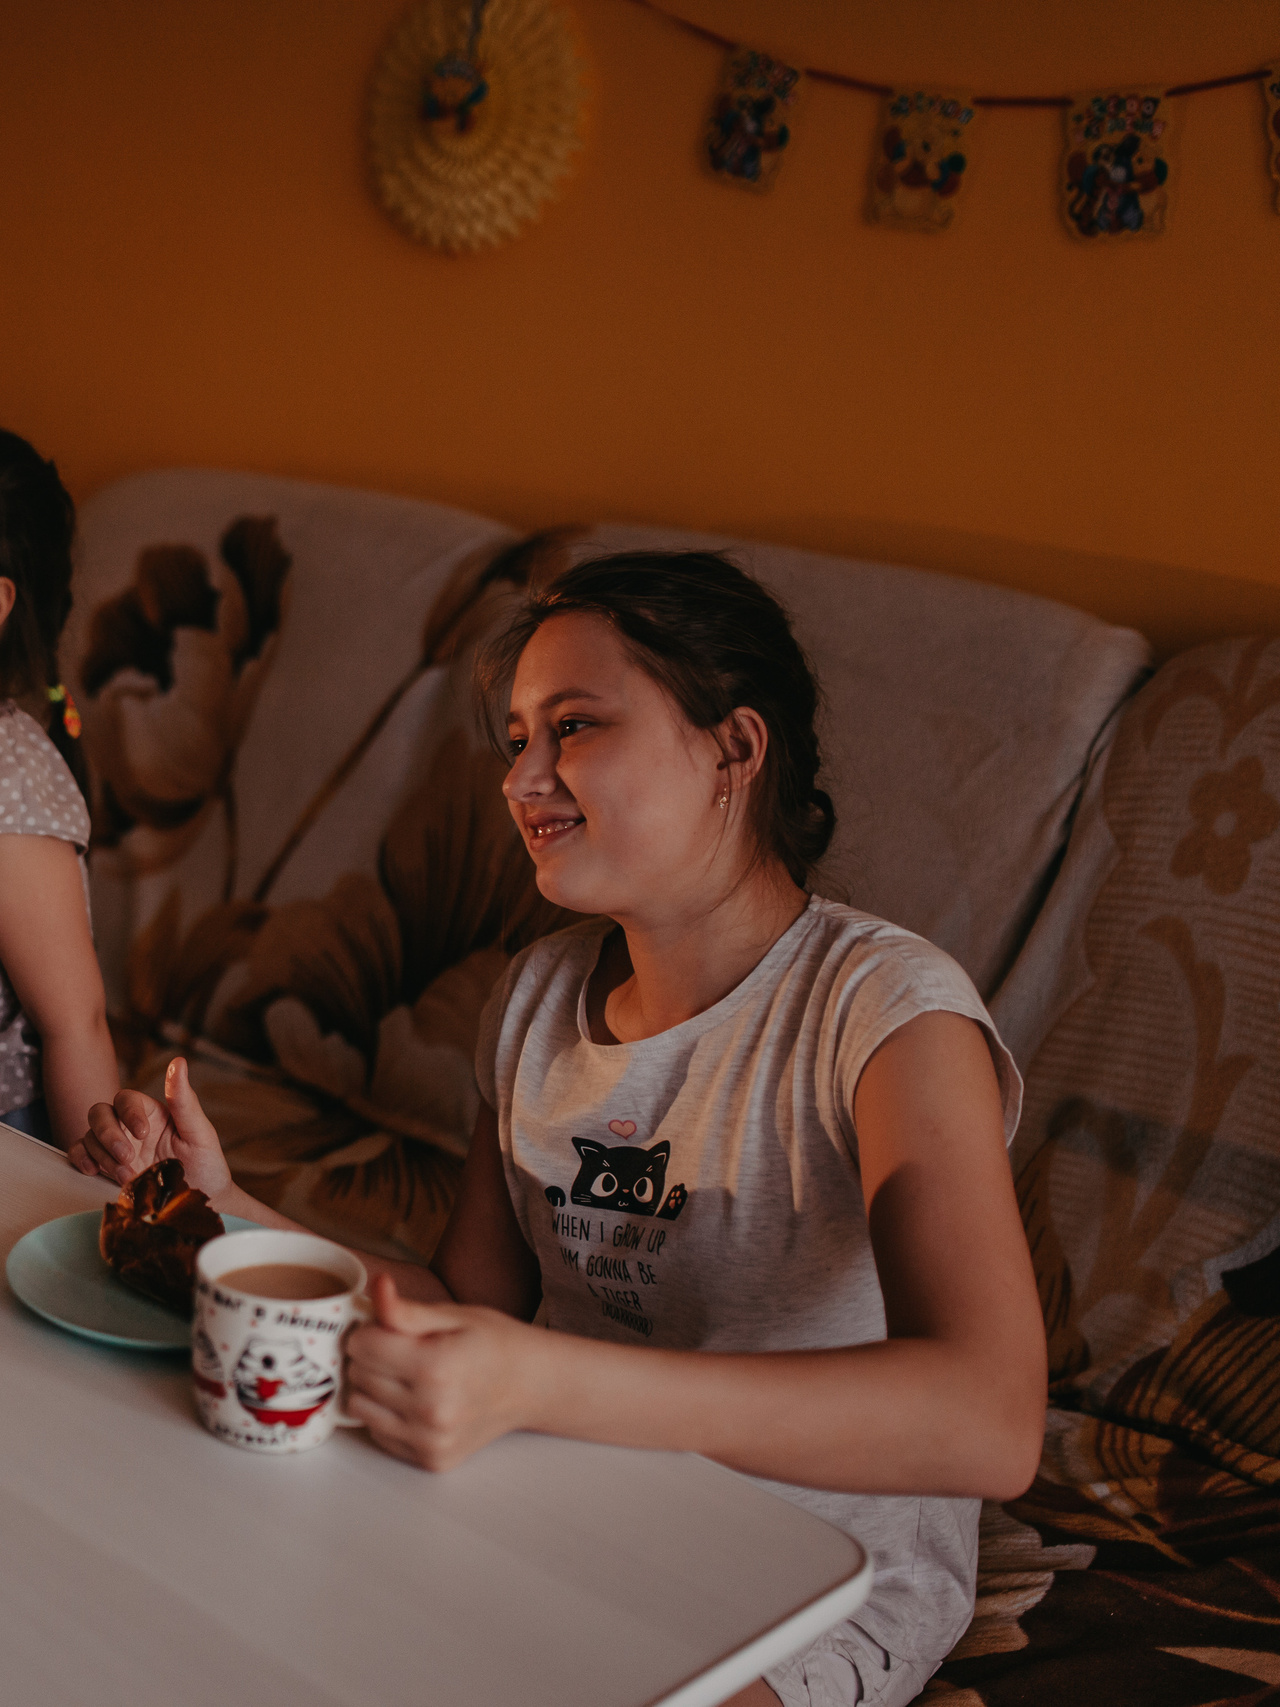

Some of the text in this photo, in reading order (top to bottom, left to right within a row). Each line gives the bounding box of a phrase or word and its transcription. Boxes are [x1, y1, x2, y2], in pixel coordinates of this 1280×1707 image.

[552, 1213, 591, 1241] WHEN
[613, 1223, 646, 1250] GROW
[647, 1228, 666, 1256] UP
[586, 1255, 633, 1284] GONNA
[637, 1261, 657, 1285] BE
[600, 1286, 643, 1312] TIGER
